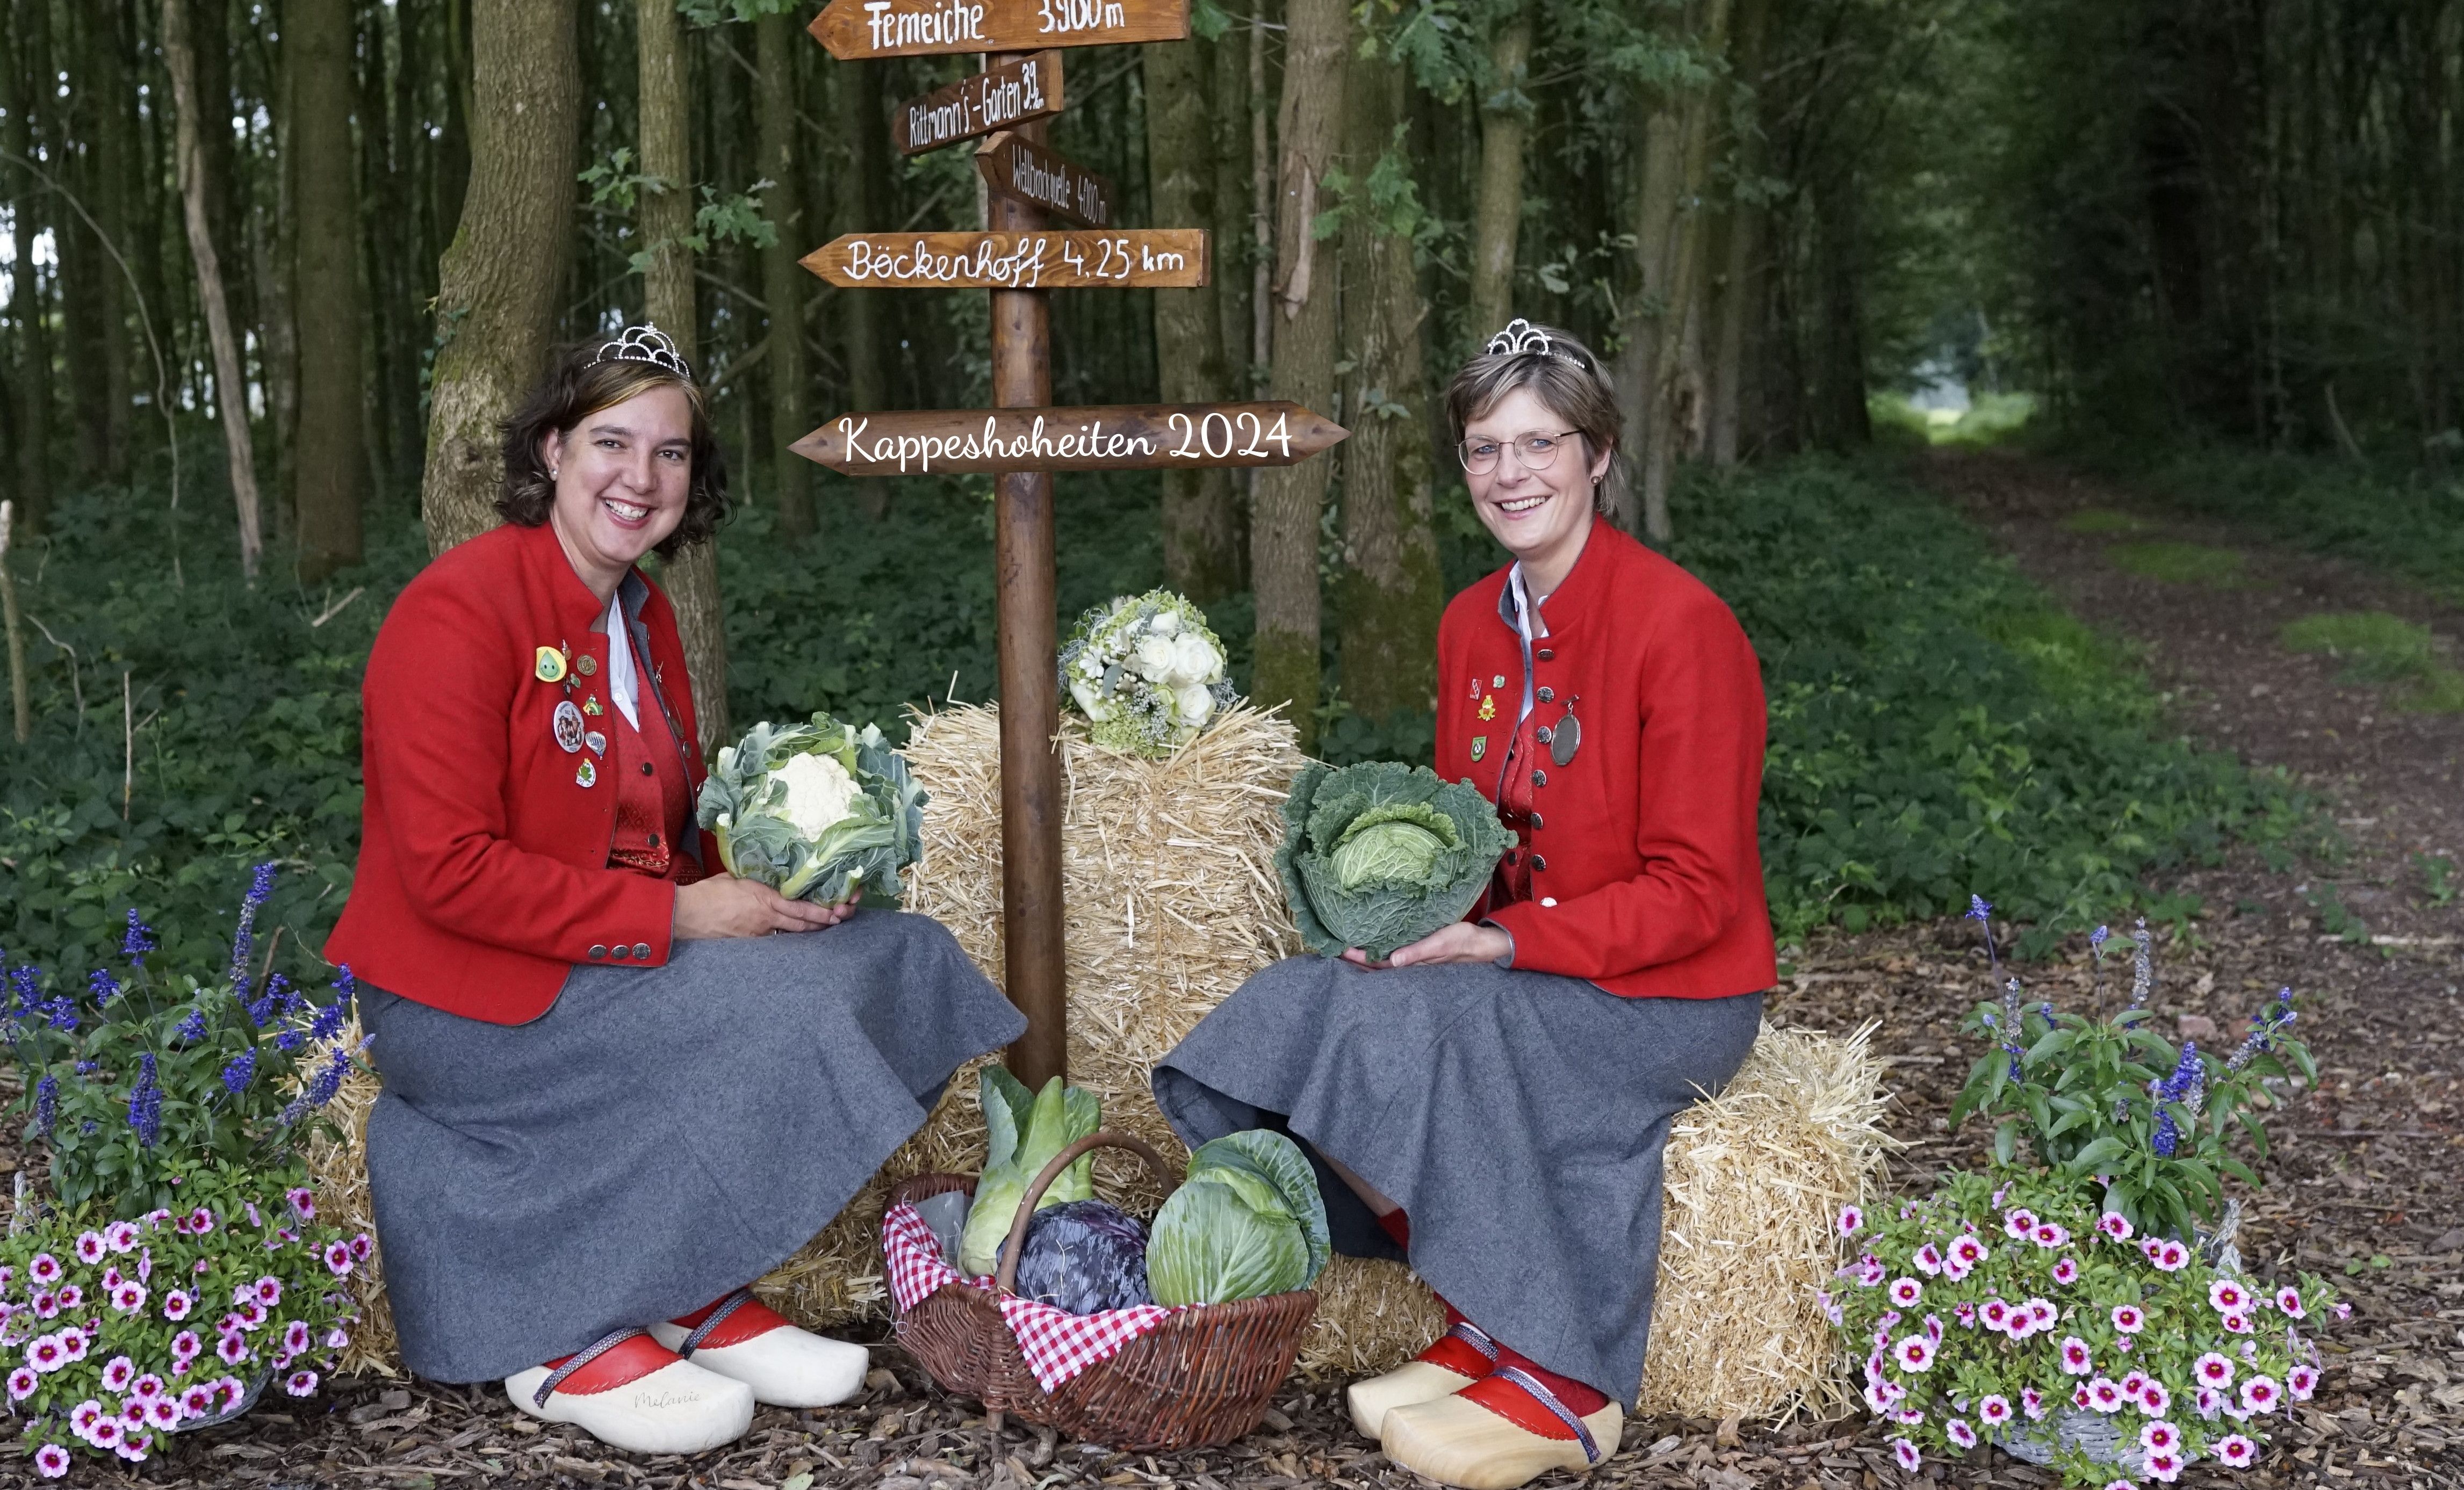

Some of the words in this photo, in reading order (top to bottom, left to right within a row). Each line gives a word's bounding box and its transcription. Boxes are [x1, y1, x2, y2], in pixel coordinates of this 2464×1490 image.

[1105, 3, 1125, 28] m
[842, 237, 1046, 287] Böckenhoff
[1142, 245, 1184, 272] km
[838, 415, 1157, 473] Kappeshoheiten
[1168, 412, 1293, 458] 2024
[635, 1391, 701, 1408] Melanie
